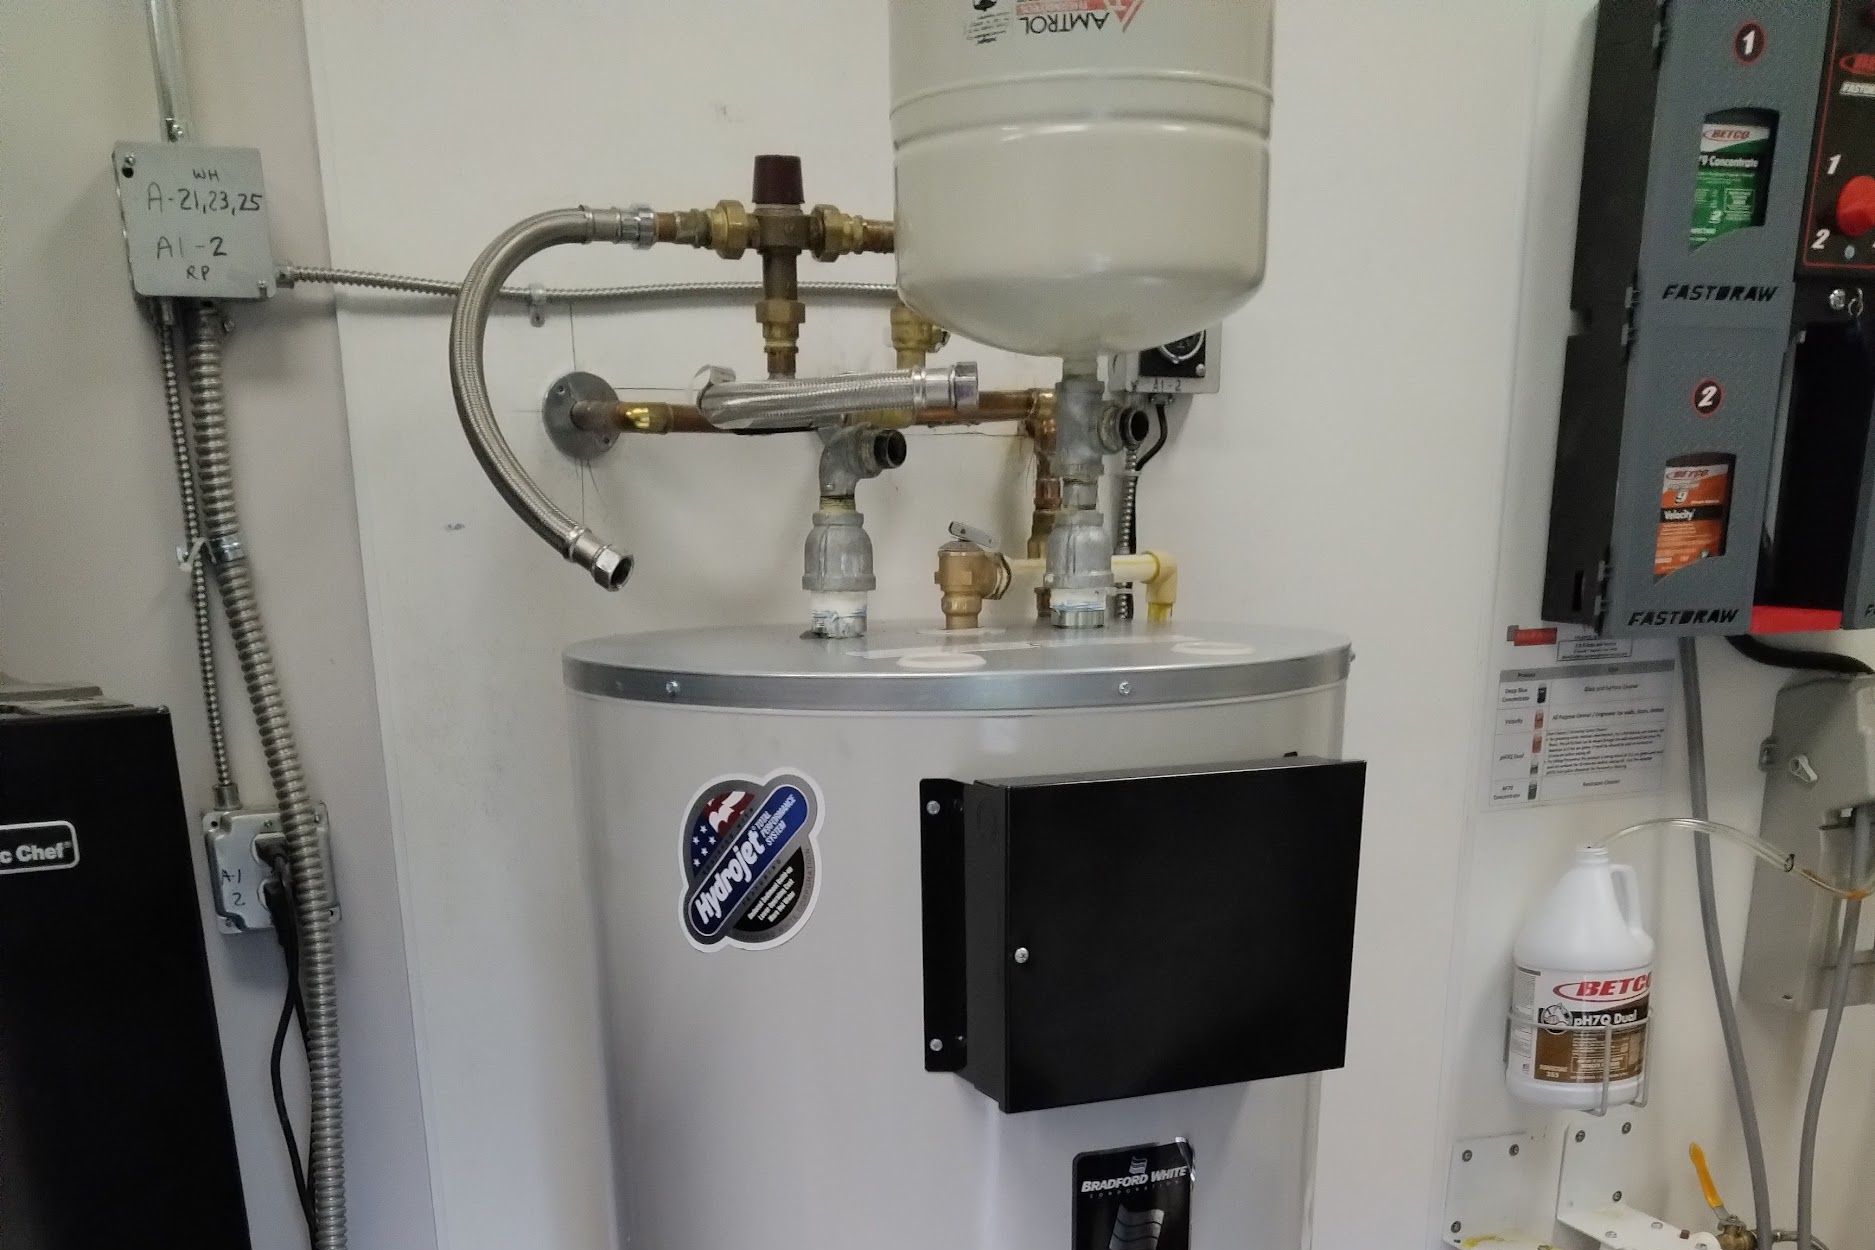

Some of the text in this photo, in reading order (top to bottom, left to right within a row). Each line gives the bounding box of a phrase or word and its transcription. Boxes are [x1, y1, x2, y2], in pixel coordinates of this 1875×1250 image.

[1018, 12, 1110, 35] AMTROL
[1743, 30, 1757, 55] 1
[1711, 129, 1750, 140] BETCO
[1710, 156, 1759, 168] Concentrate
[1827, 154, 1841, 175] 1
[193, 169, 219, 182] WH
[1811, 229, 1830, 249] 2
[186, 265, 210, 280] RP
[1662, 284, 1779, 301] FASTDRAW
[1698, 386, 1717, 407] 2
[1628, 609, 1740, 626] FASTDRAW
[760, 794, 796, 838] PERFORMANCE
[765, 820, 787, 846] SYSTEM
[695, 829, 766, 925] Hydrojet
[232, 892, 246, 907] 2
[1613, 1009, 1637, 1024] Dual
[1081, 1165, 1188, 1193] BRADFORD WHITE
